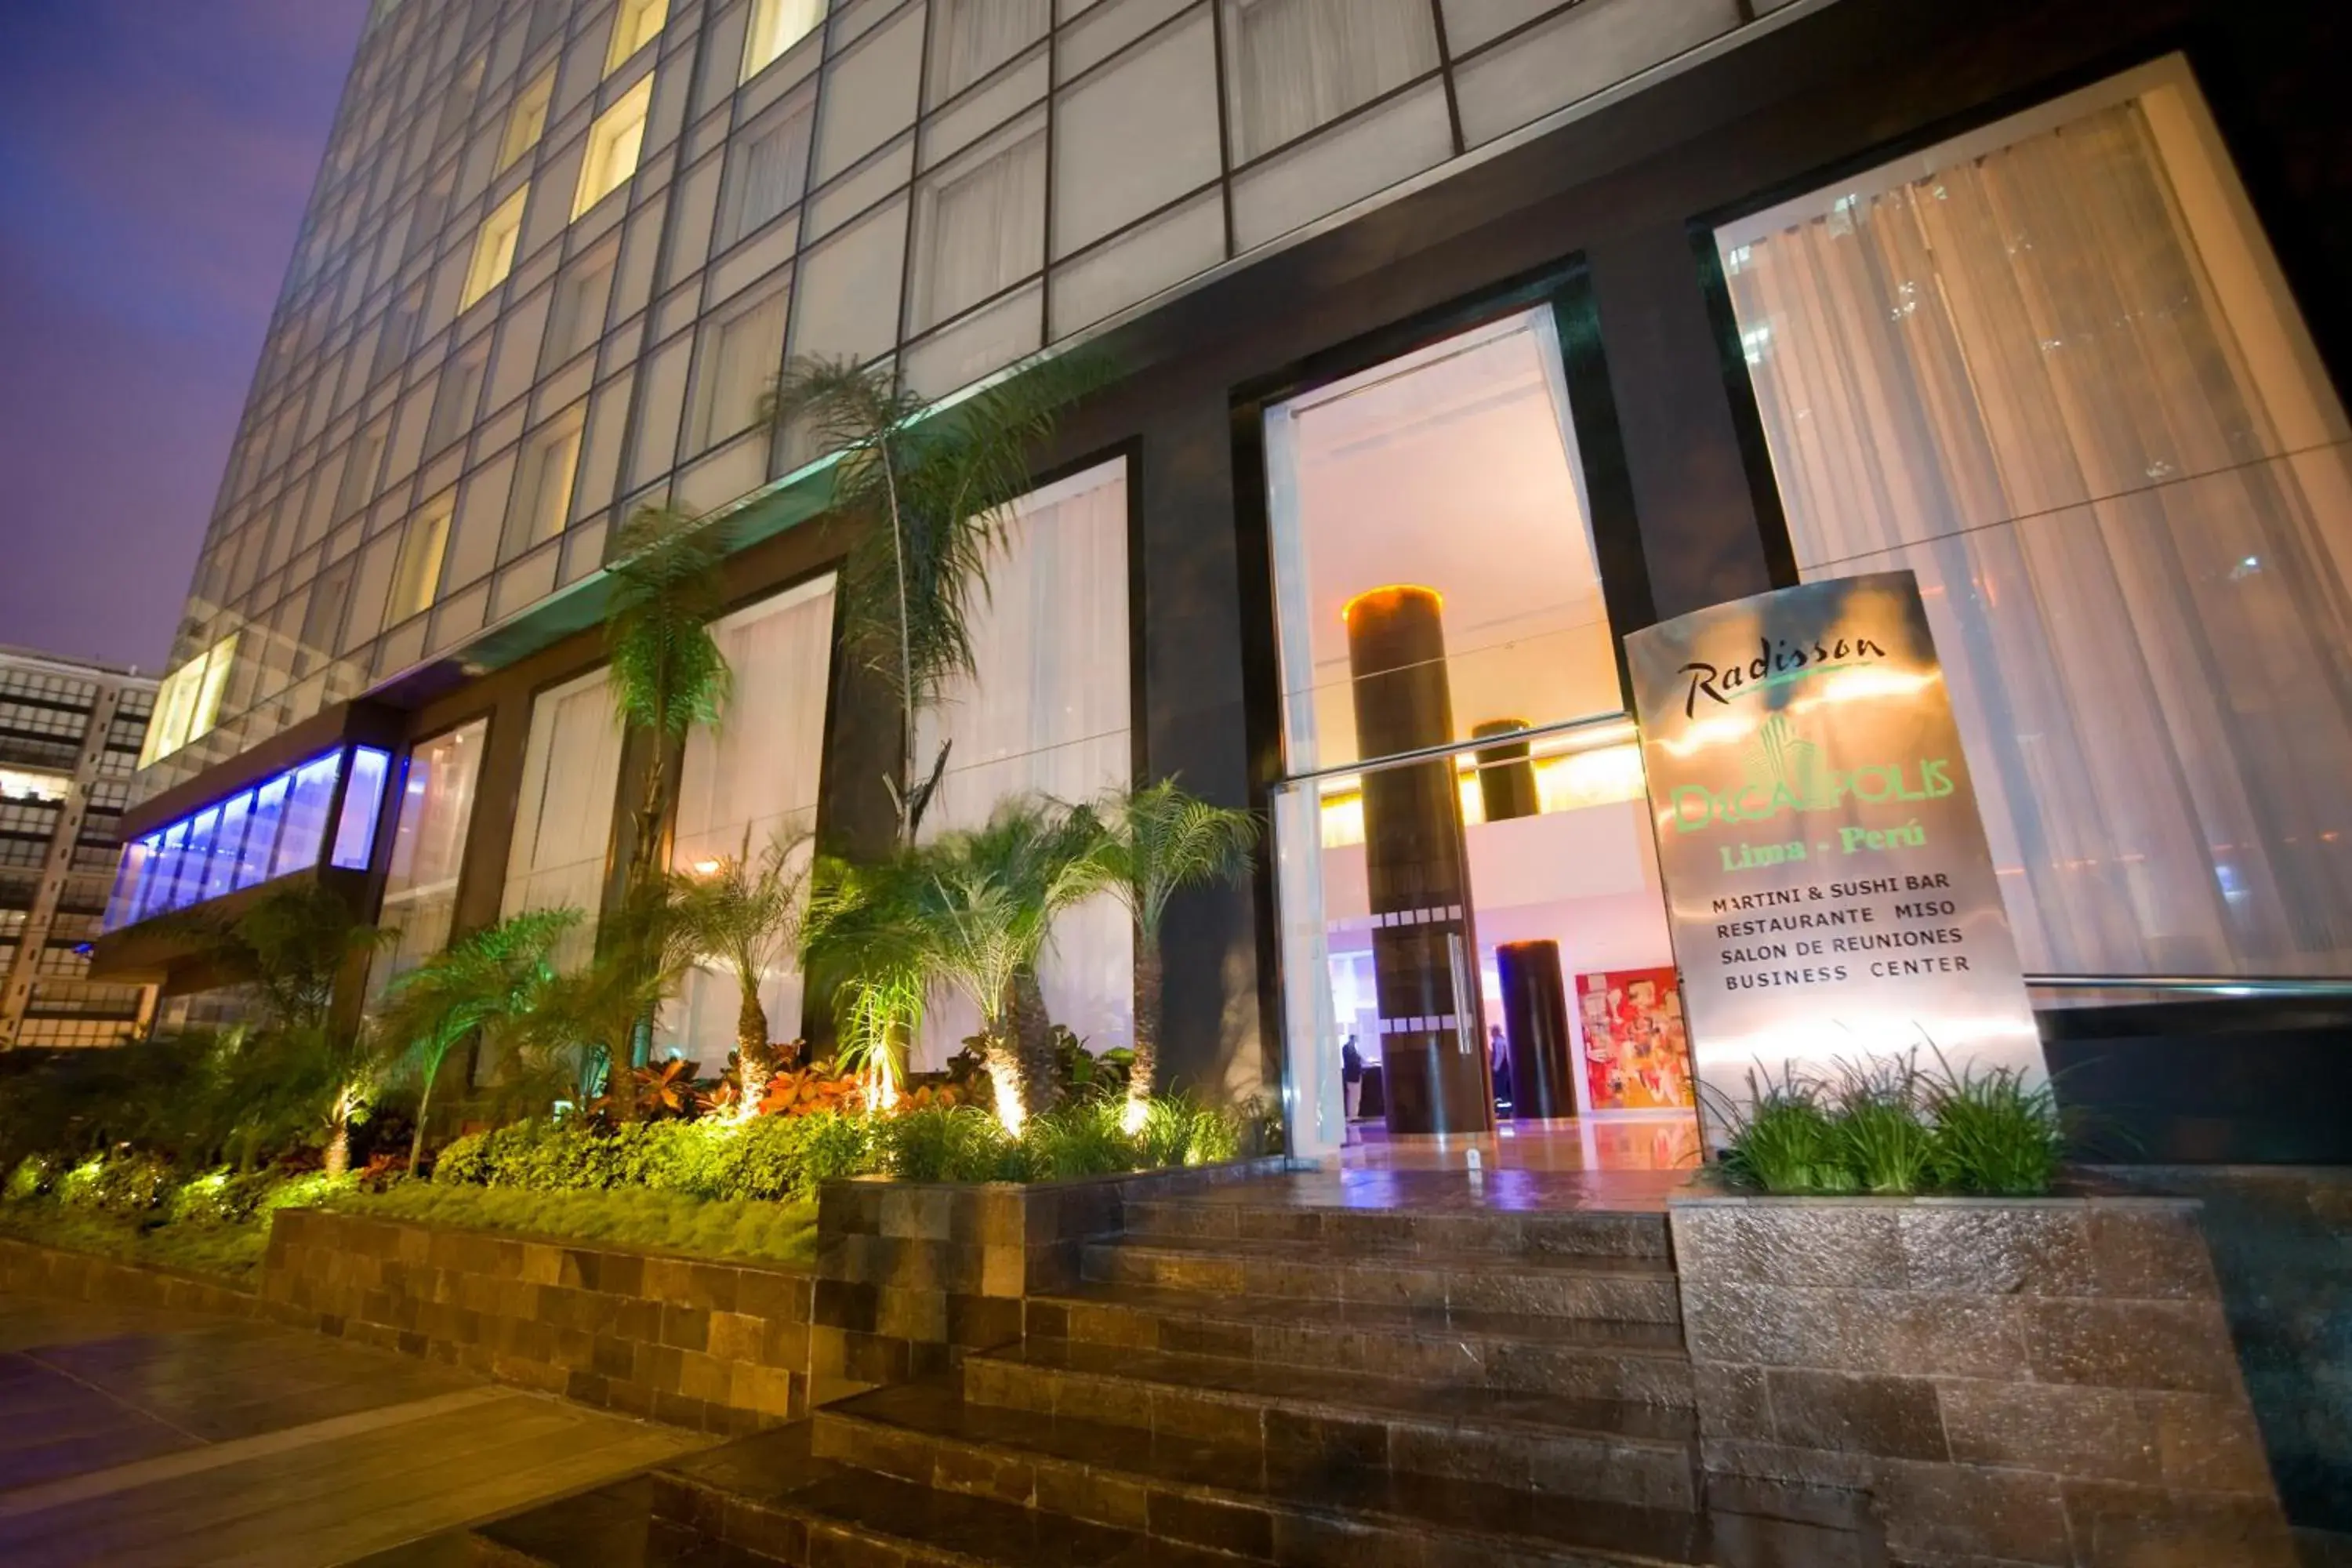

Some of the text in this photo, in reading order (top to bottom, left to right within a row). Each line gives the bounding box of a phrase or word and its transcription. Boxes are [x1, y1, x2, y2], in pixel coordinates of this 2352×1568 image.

[1678, 637, 1886, 719] Radisson
[1719, 841, 1806, 872] Lima
[1838, 817, 1926, 855] Perú
[1712, 872, 1950, 914] MARTINI & SUSHI BAR
[1717, 900, 1955, 939] RESTAURANTE MISO
[1721, 927, 1963, 965] SALON DE REUNIONES
[1726, 956, 1970, 991] BUSINESS CENTER
